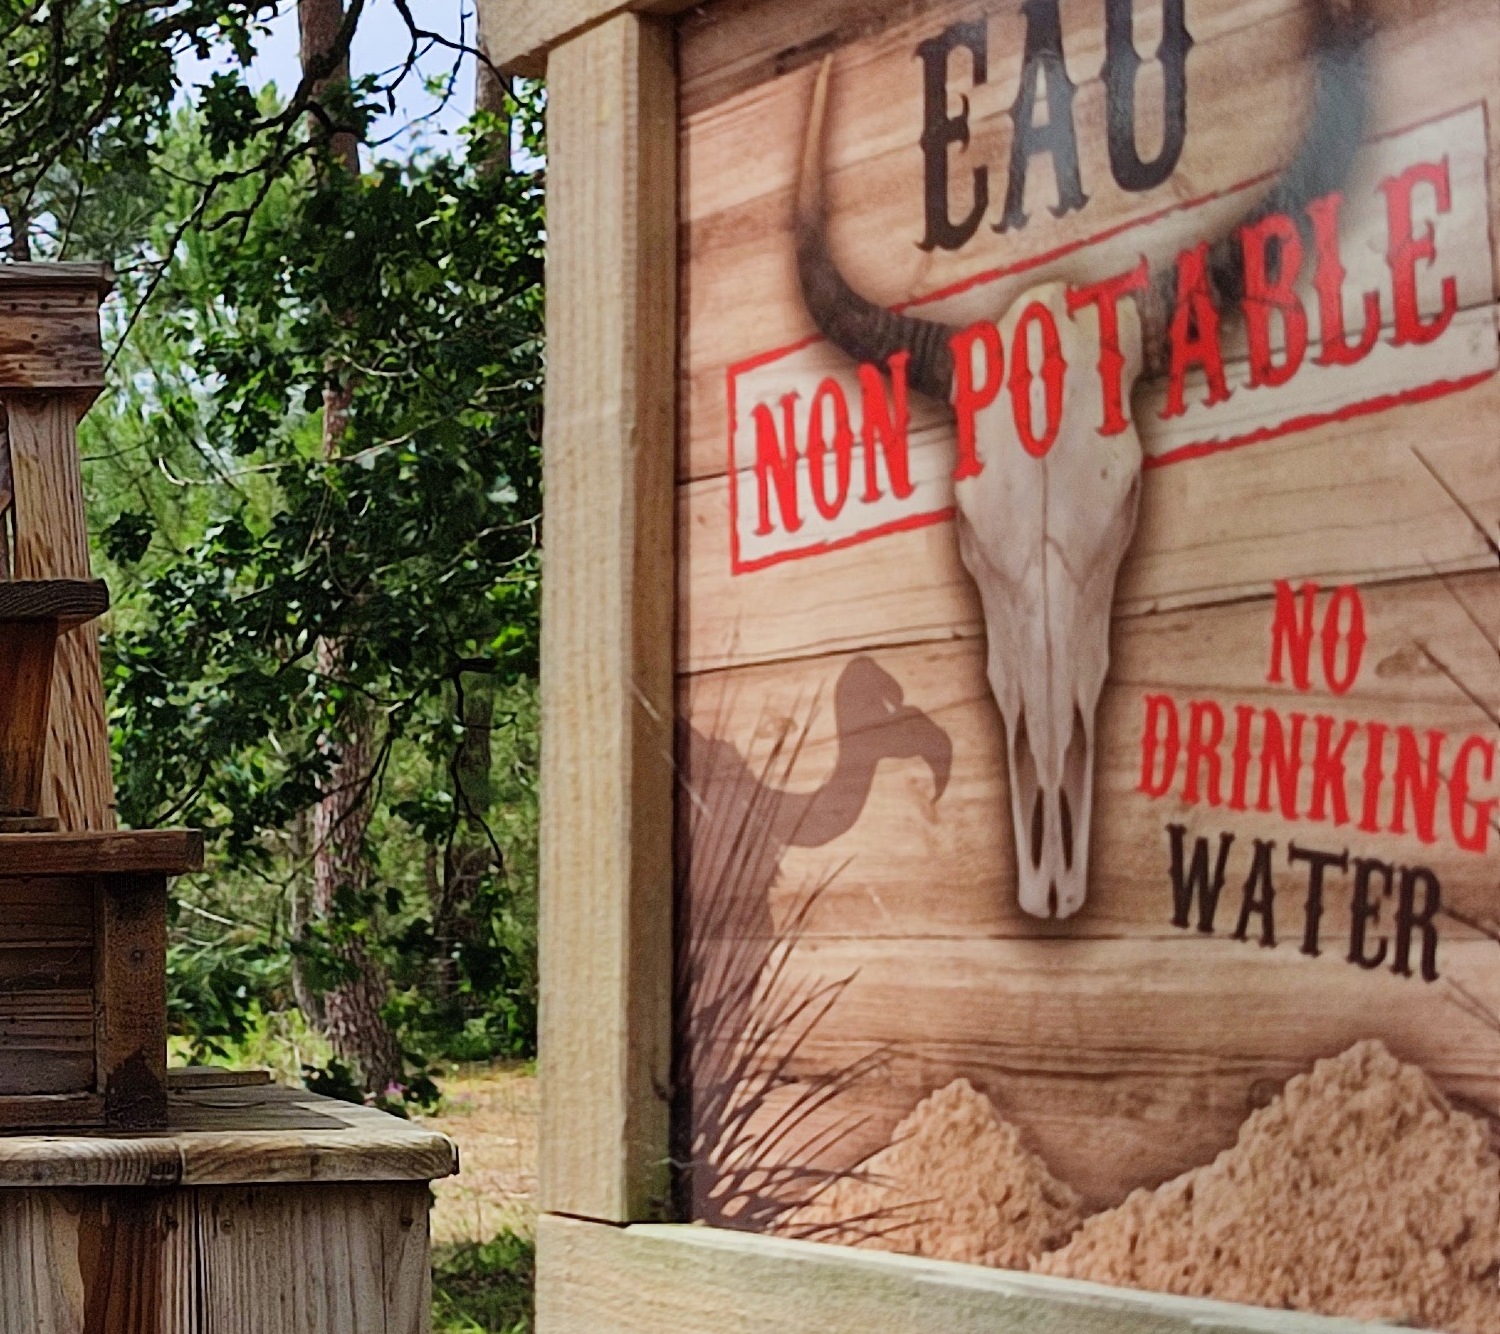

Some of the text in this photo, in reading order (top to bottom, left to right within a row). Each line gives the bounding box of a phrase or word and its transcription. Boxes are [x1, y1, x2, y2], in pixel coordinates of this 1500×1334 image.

[748, 154, 1459, 536] NON POTABLE
[1266, 578, 1369, 696] NO
[1135, 694, 1500, 855] DRINKING
[1164, 822, 1443, 983] WATER
